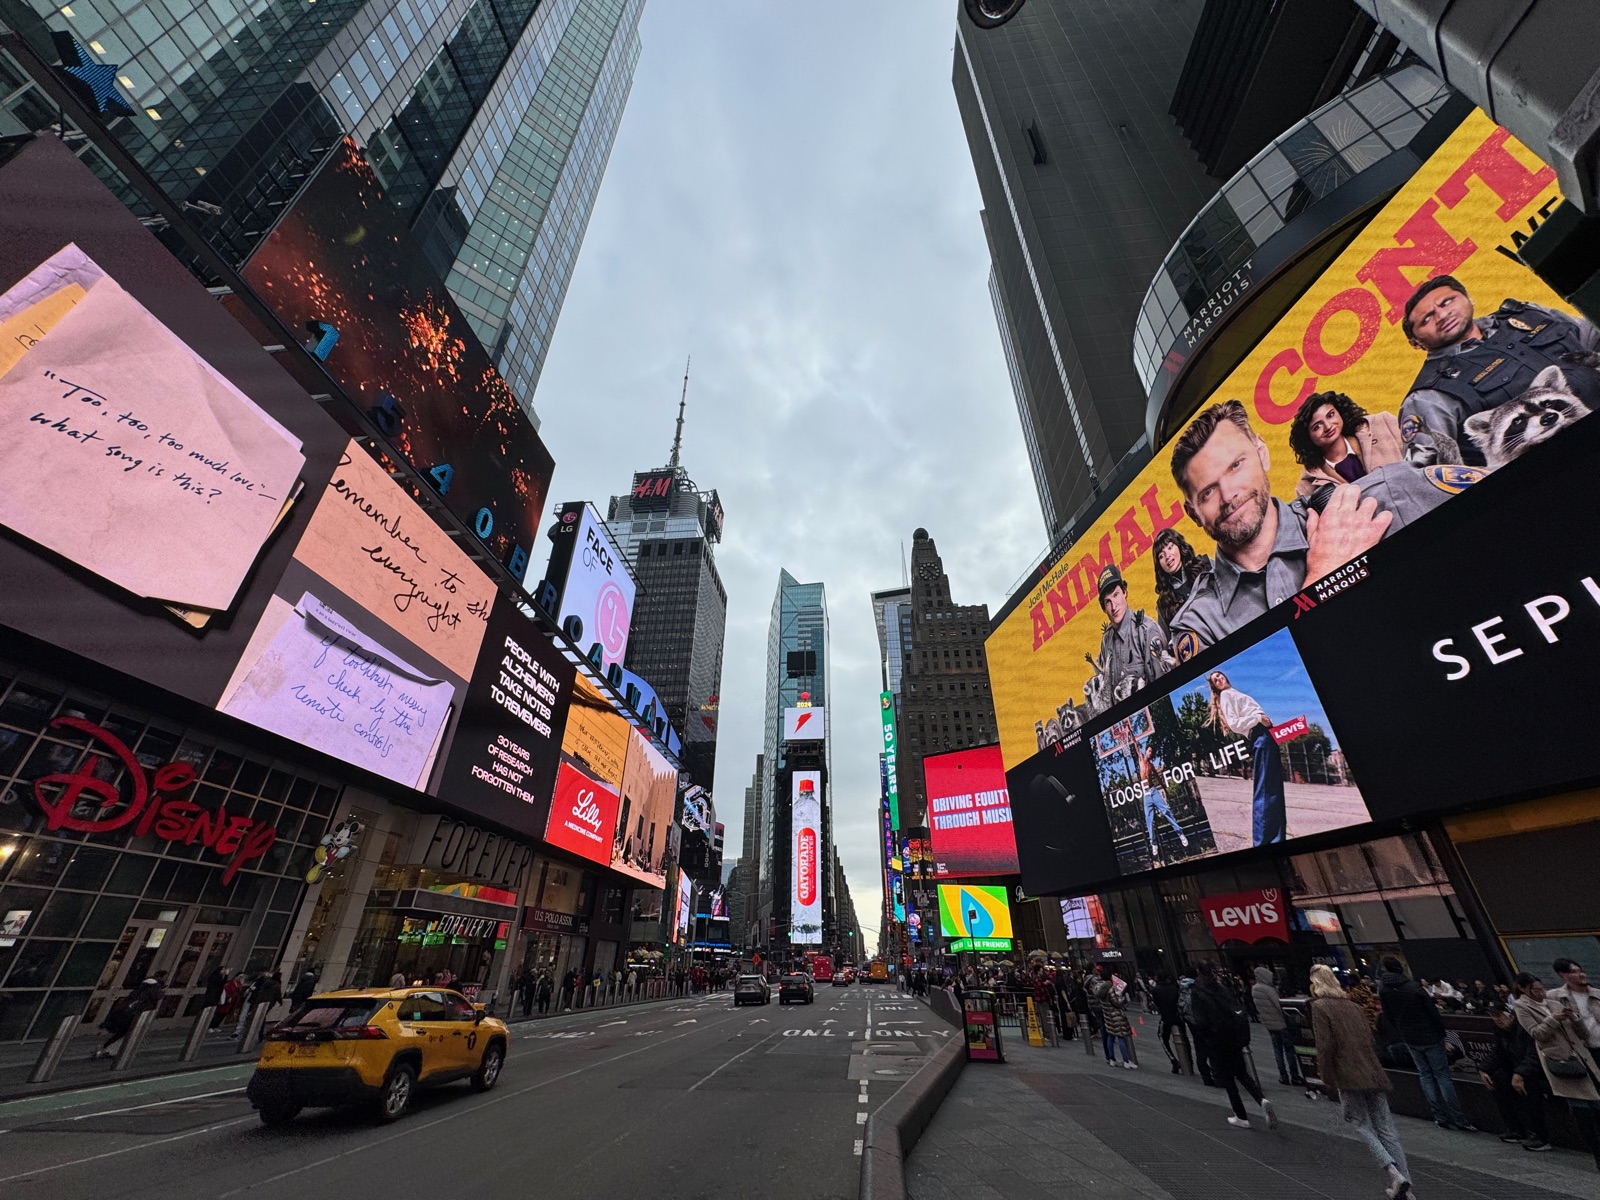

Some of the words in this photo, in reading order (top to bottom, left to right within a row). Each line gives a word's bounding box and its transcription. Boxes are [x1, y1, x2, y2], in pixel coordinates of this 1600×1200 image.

[1183, 259, 1252, 339] MARRIOTT
[1188, 279, 1249, 349] MARQUIS
[30, 412, 105, 443] what
[105, 446, 143, 472] song
[148, 462, 165, 476] is
[172, 472, 223, 504] this?
[158, 432, 184, 451] too
[188, 450, 229, 475] much
[632, 476, 672, 498] H&M
[560, 524, 574, 534] LG
[1048, 529, 1075, 561] MARRIOTT
[582, 547, 598, 572] OF
[586, 525, 614, 577] FACE
[1029, 482, 1185, 653] ANIMAL
[1050, 540, 1075, 568] MARQUIS
[436, 567, 466, 594] to
[1028, 587, 1043, 609] Joel
[1042, 562, 1070, 595] McHale
[1315, 555, 1369, 593] MARRIOTT
[1319, 568, 1367, 601] MARQUIS
[1432, 576, 1600, 681] SEP
[504, 635, 540, 674] PEOPLE
[539, 666, 561, 693] WITH
[328, 669, 361, 704] check
[370, 698, 386, 732] by
[389, 706, 414, 735] the
[490, 684, 506, 704] TO
[503, 695, 552, 739] REMEMBER
[499, 670, 524, 699] TAKE
[522, 690, 552, 720] NOTES
[291, 684, 345, 723] remote
[353, 723, 394, 758] controls
[884, 723, 894, 742] 50
[1062, 728, 1082, 744] MARRIOTT
[487, 743, 500, 756] OF
[497, 749, 534, 777] RESEARCH
[497, 734, 510, 748] 30
[509, 740, 531, 761] YEARS
[1063, 736, 1082, 751] MARQUIS
[471, 765, 517, 796] FORGOTTEN
[516, 787, 535, 805] THEM
[492, 760, 509, 777] HAS
[507, 769, 524, 785] NOT
[886, 744, 898, 794] YEARS
[1108, 779, 1151, 809] LOOSE
[1162, 761, 1197, 788] FOR
[1209, 739, 1250, 771] LIFE
[571, 788, 603, 833] Lilly
[932, 793, 973, 813] DRIVING
[933, 810, 981, 831] THROUGH
[422, 814, 533, 888] FOREVER
[799, 835, 809, 899] GATORADE
[436, 914, 485, 937] FOREVER
[483, 920, 498, 938] 21
[535, 910, 544, 922] U.S.
[544, 912, 560, 924] POLO
[559, 914, 573, 927] ASSN.
[783, 1029, 857, 1037] ONLY
[875, 1029, 949, 1037] ONLY
